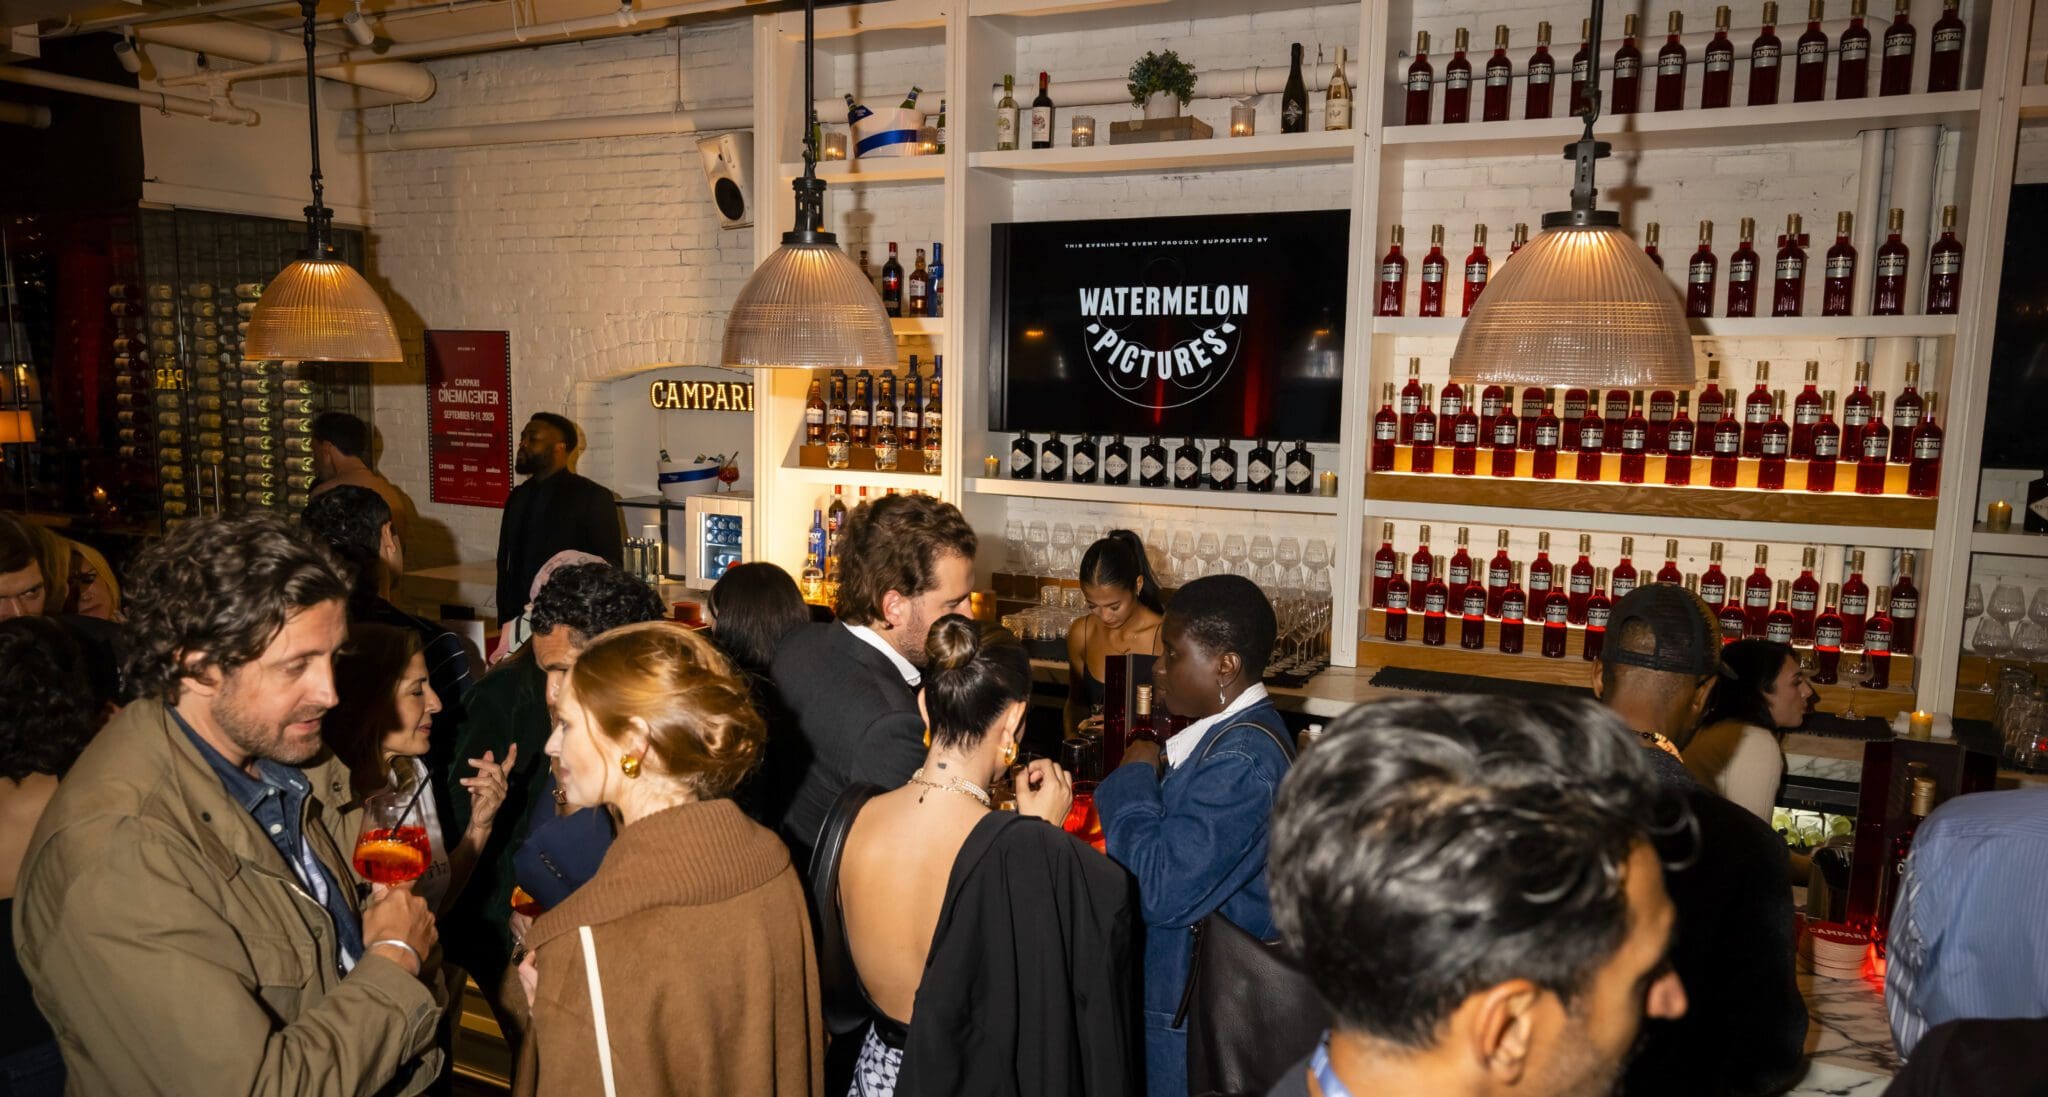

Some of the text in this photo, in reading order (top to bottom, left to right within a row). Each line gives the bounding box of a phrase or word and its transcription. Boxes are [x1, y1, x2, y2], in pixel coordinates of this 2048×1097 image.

[1572, 64, 1588, 72] CAMP
[1079, 285, 1249, 316] WATERMELON
[1093, 328, 1227, 380] PICTURES
[455, 378, 480, 387] CAMPARI
[651, 381, 754, 411] CAMPARI
[444, 410, 470, 420] SEPTEMBER
[482, 412, 495, 422] 2025
[1808, 927, 1868, 940] CAMPARI
